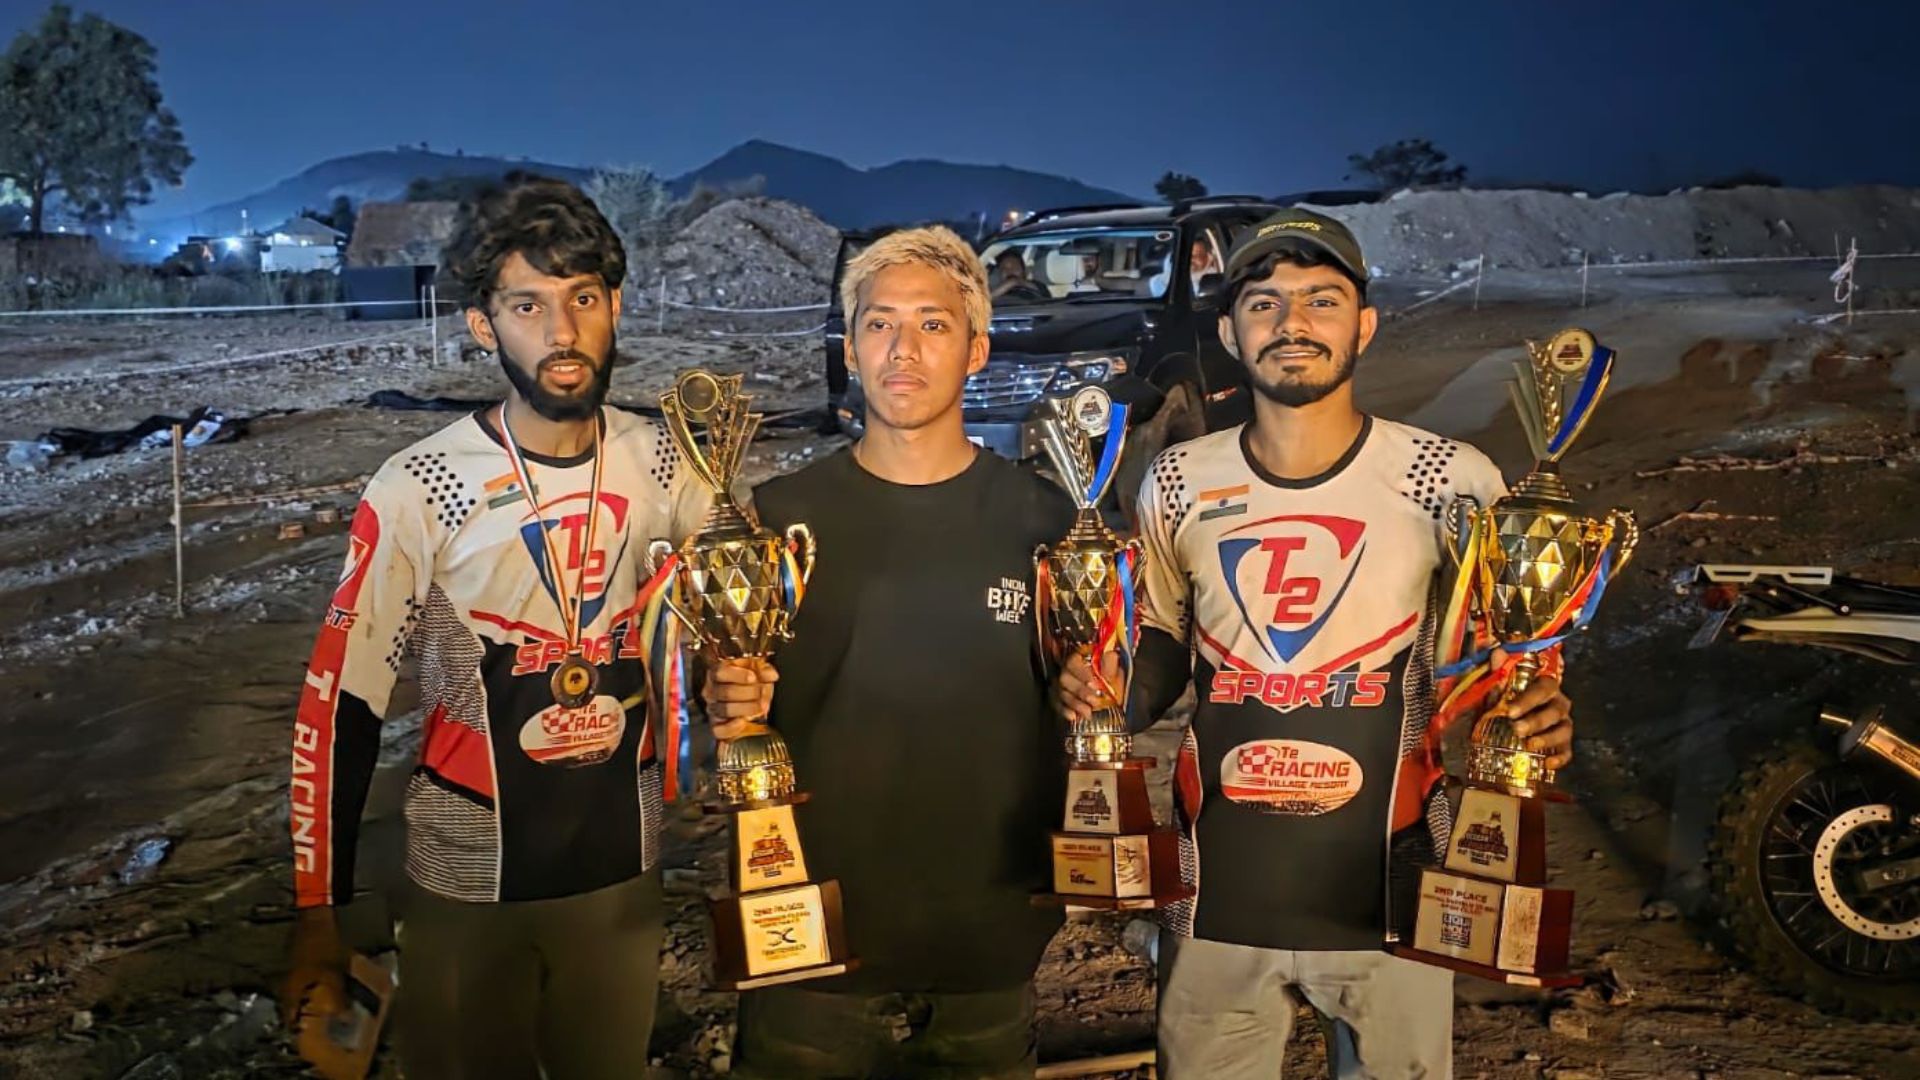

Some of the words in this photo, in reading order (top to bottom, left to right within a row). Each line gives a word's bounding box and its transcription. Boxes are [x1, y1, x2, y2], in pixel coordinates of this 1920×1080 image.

[1260, 537, 1321, 623] T2
[1210, 671, 1391, 708] SPORTS
[1269, 761, 1350, 777] RACING
[291, 722, 319, 874] RACING
[1434, 885, 1454, 897] 2ND
[1456, 890, 1488, 904] PLACE
